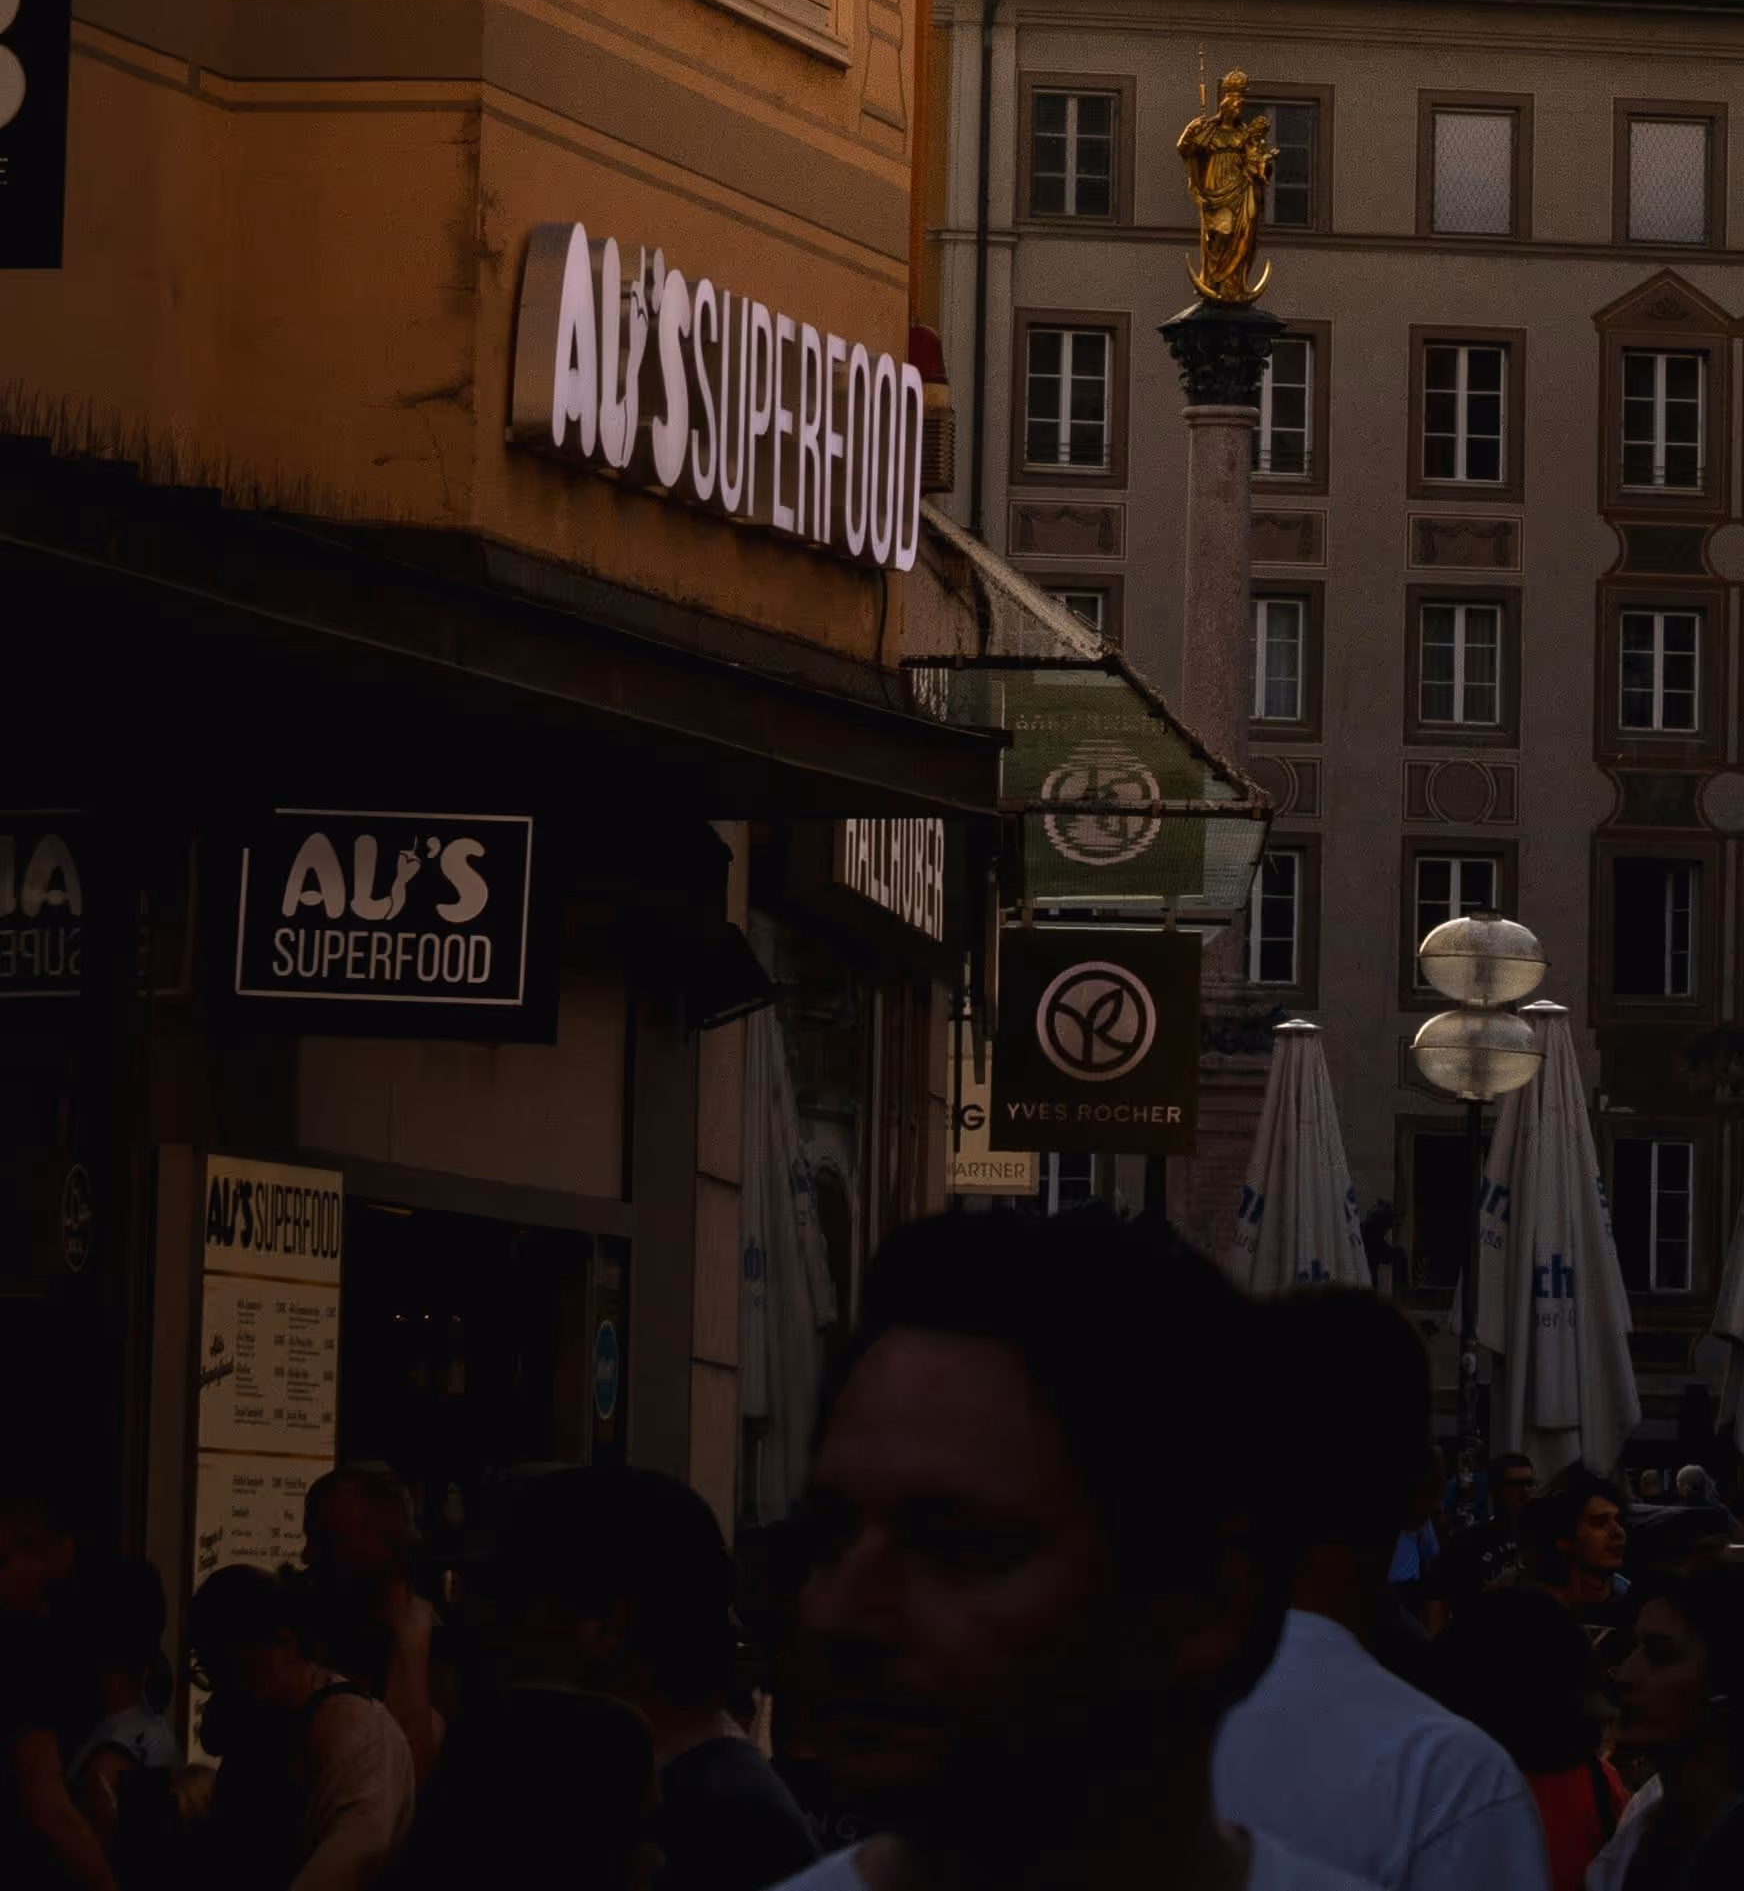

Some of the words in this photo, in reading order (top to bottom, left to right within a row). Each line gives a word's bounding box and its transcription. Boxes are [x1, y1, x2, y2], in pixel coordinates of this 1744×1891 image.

[691, 279, 924, 571] SUPERFOOD
[844, 818, 944, 942] HALLHUBER
[273, 926, 492, 985] SUPERFOOD
[1006, 1102, 1068, 1122] YVES
[1077, 1103, 1183, 1124] ROCHER
[255, 1182, 340, 1259] SUPERFOOD
